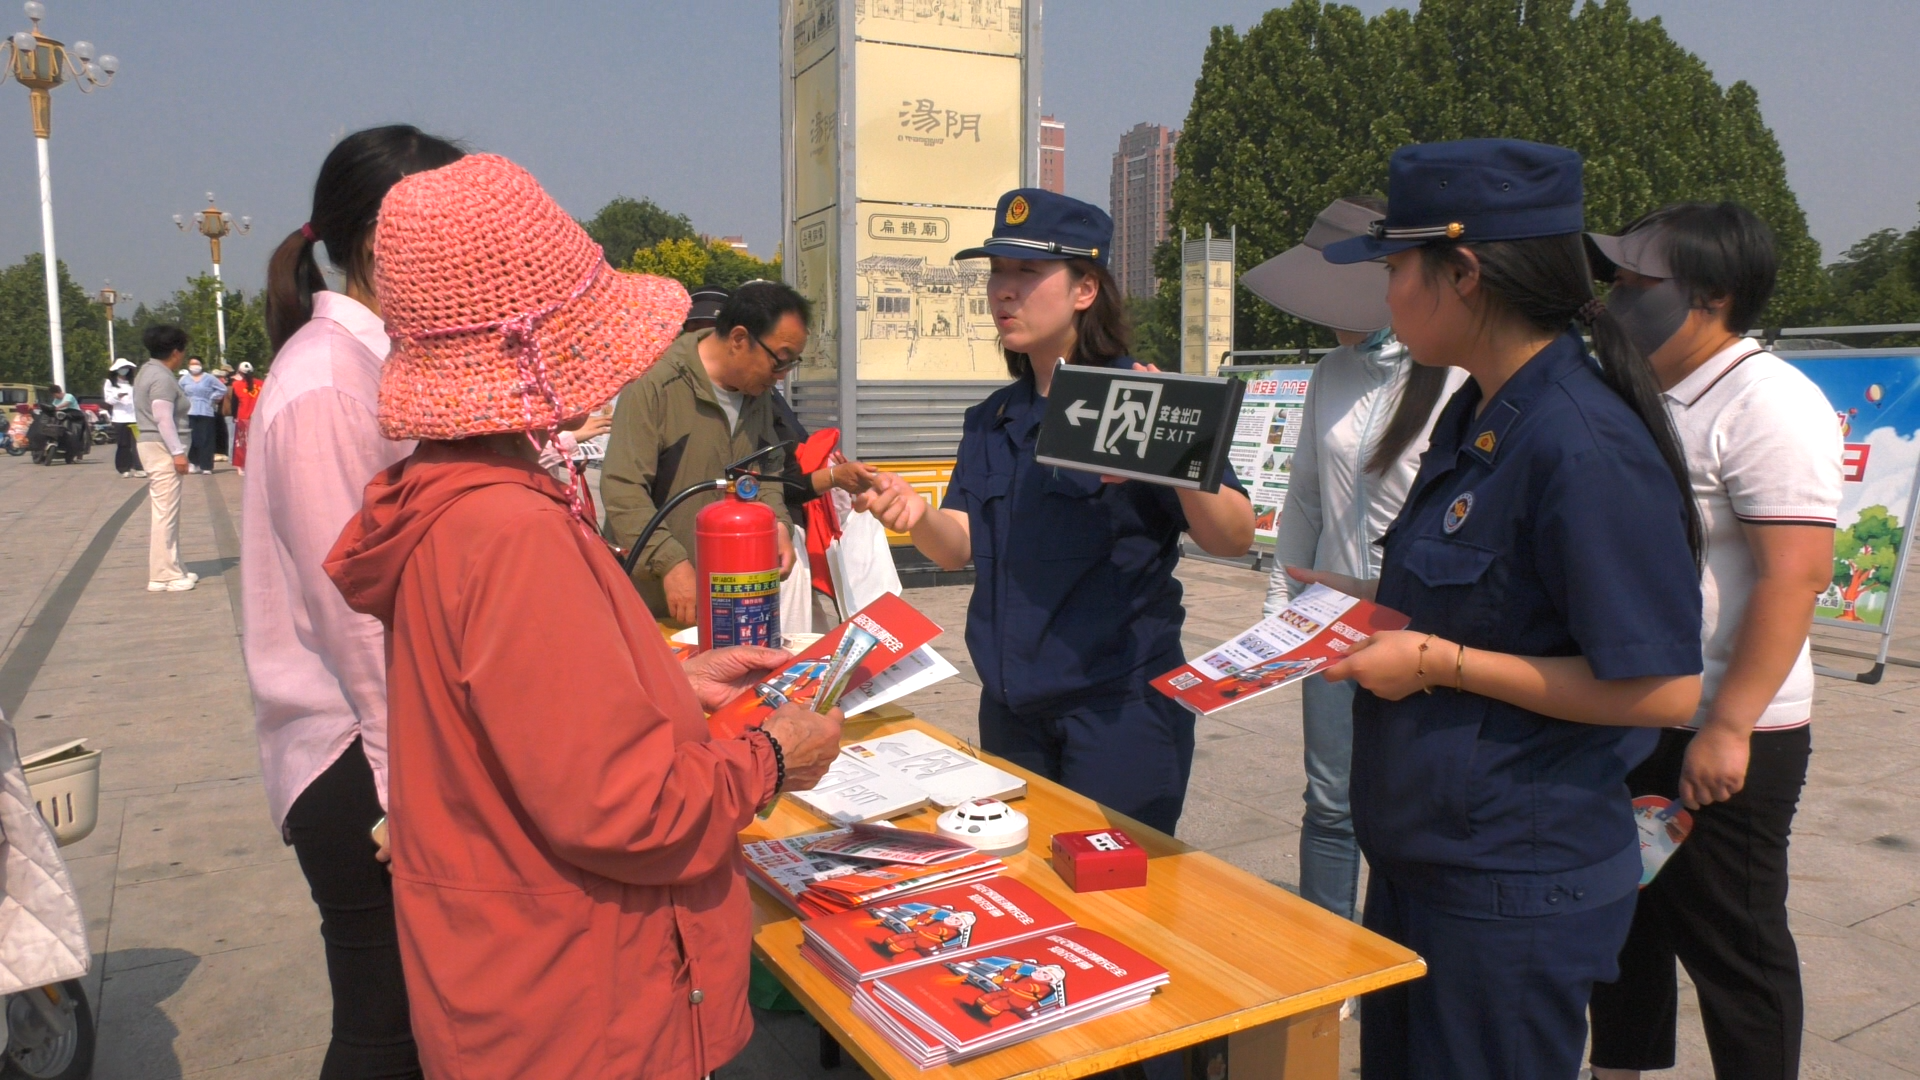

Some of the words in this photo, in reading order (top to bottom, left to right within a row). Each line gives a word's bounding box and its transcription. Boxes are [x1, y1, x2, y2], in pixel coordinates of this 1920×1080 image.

[1158, 405, 1201, 425] 安全出口
[1153, 427, 1196, 444] EXIT
